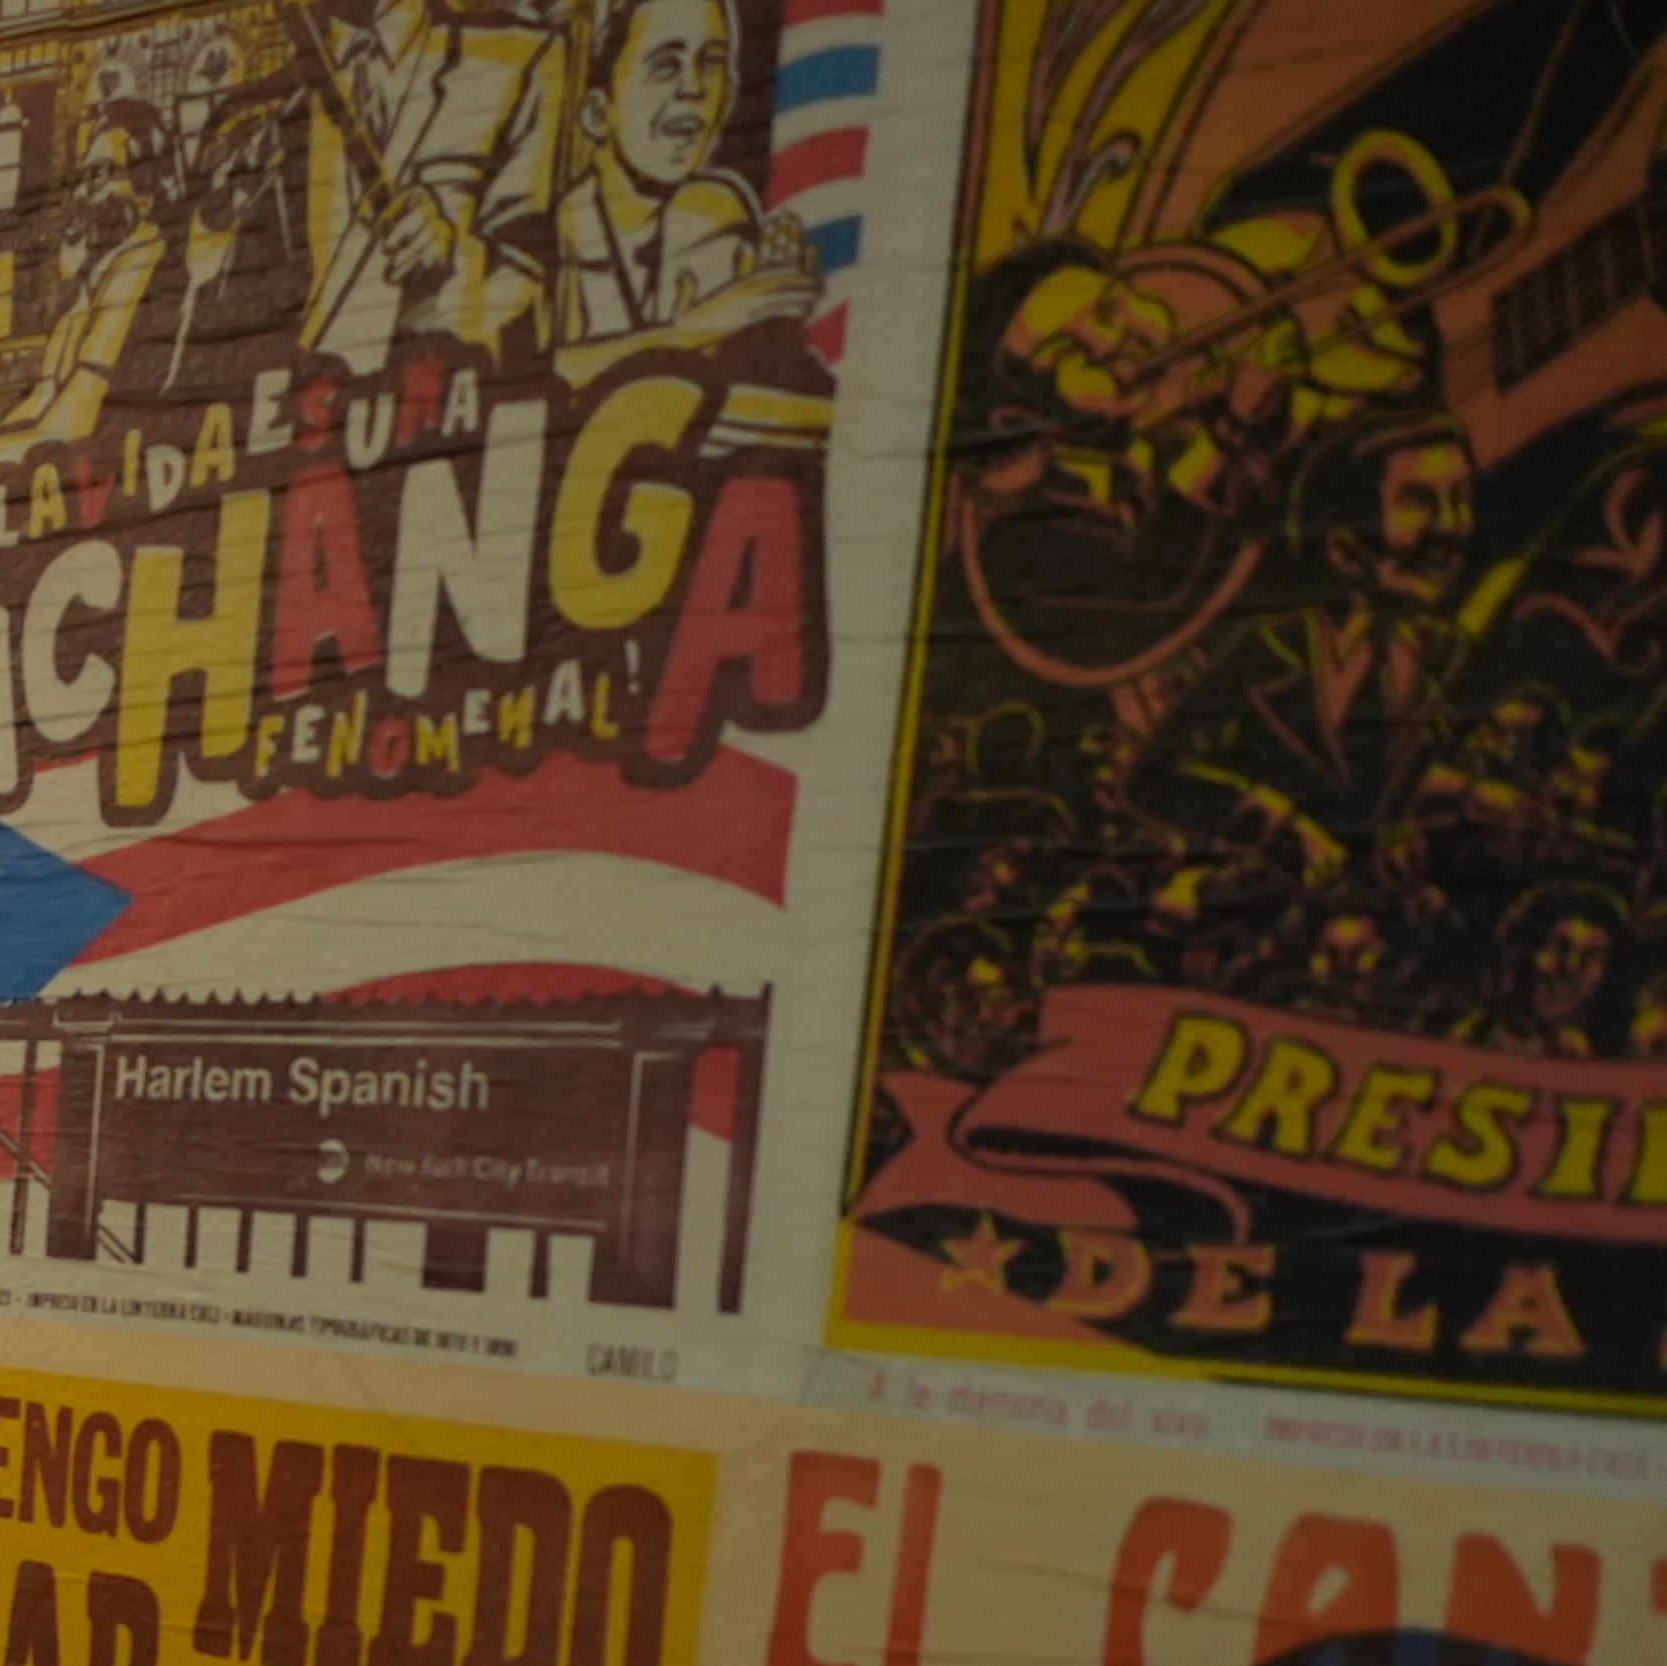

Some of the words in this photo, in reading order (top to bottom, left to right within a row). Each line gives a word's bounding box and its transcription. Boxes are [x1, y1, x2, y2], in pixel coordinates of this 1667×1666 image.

[76, 402, 236, 528] VIDA
[246, 368, 338, 454] ES
[345, 357, 480, 470] UNA
[115, 1053, 271, 1102] Harlem
[287, 1056, 490, 1119] Spanish
[1045, 1226, 1275, 1332] DE
[1343, 1247, 1587, 1360] LA
